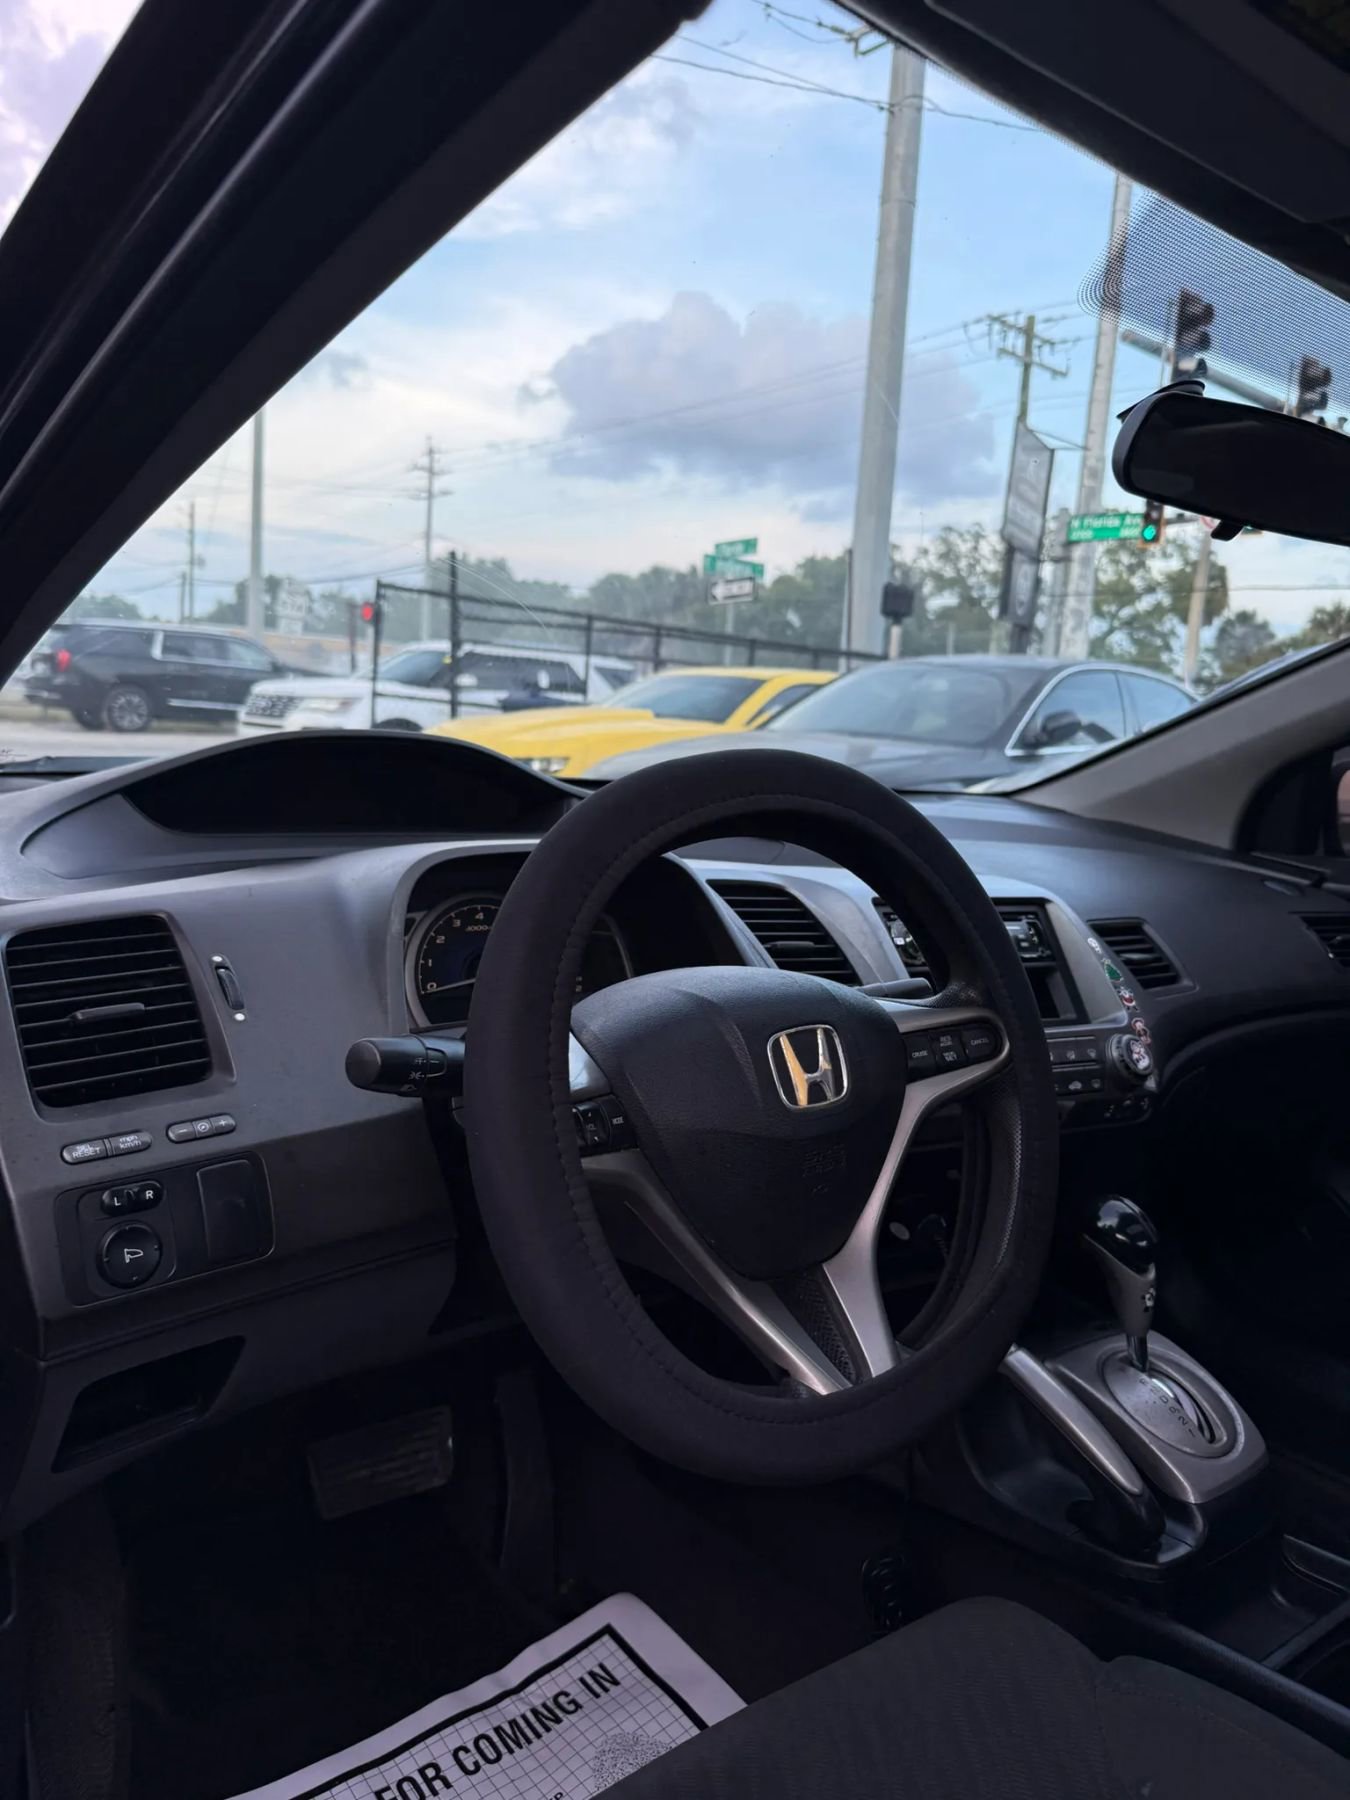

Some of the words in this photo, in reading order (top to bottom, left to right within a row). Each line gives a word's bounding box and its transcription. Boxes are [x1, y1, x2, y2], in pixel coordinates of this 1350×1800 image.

[1070, 519, 1080, 529] N
[1083, 516, 1121, 530] Florida
[474, 912, 484, 920] 4
[452, 919, 461, 928] 3
[435, 935, 445, 944] 2
[427, 958, 433, 968] 1
[426, 981, 438, 991] 0
[72, 1147, 101, 1159] RESET
[145, 1190, 154, 1200] R
[114, 1197, 122, 1207] L
[1178, 1416, 1188, 1426] 2
[374, 1762, 454, 1800] FOR
[452, 1690, 583, 1776] COMING
[578, 1662, 621, 1700] IN
